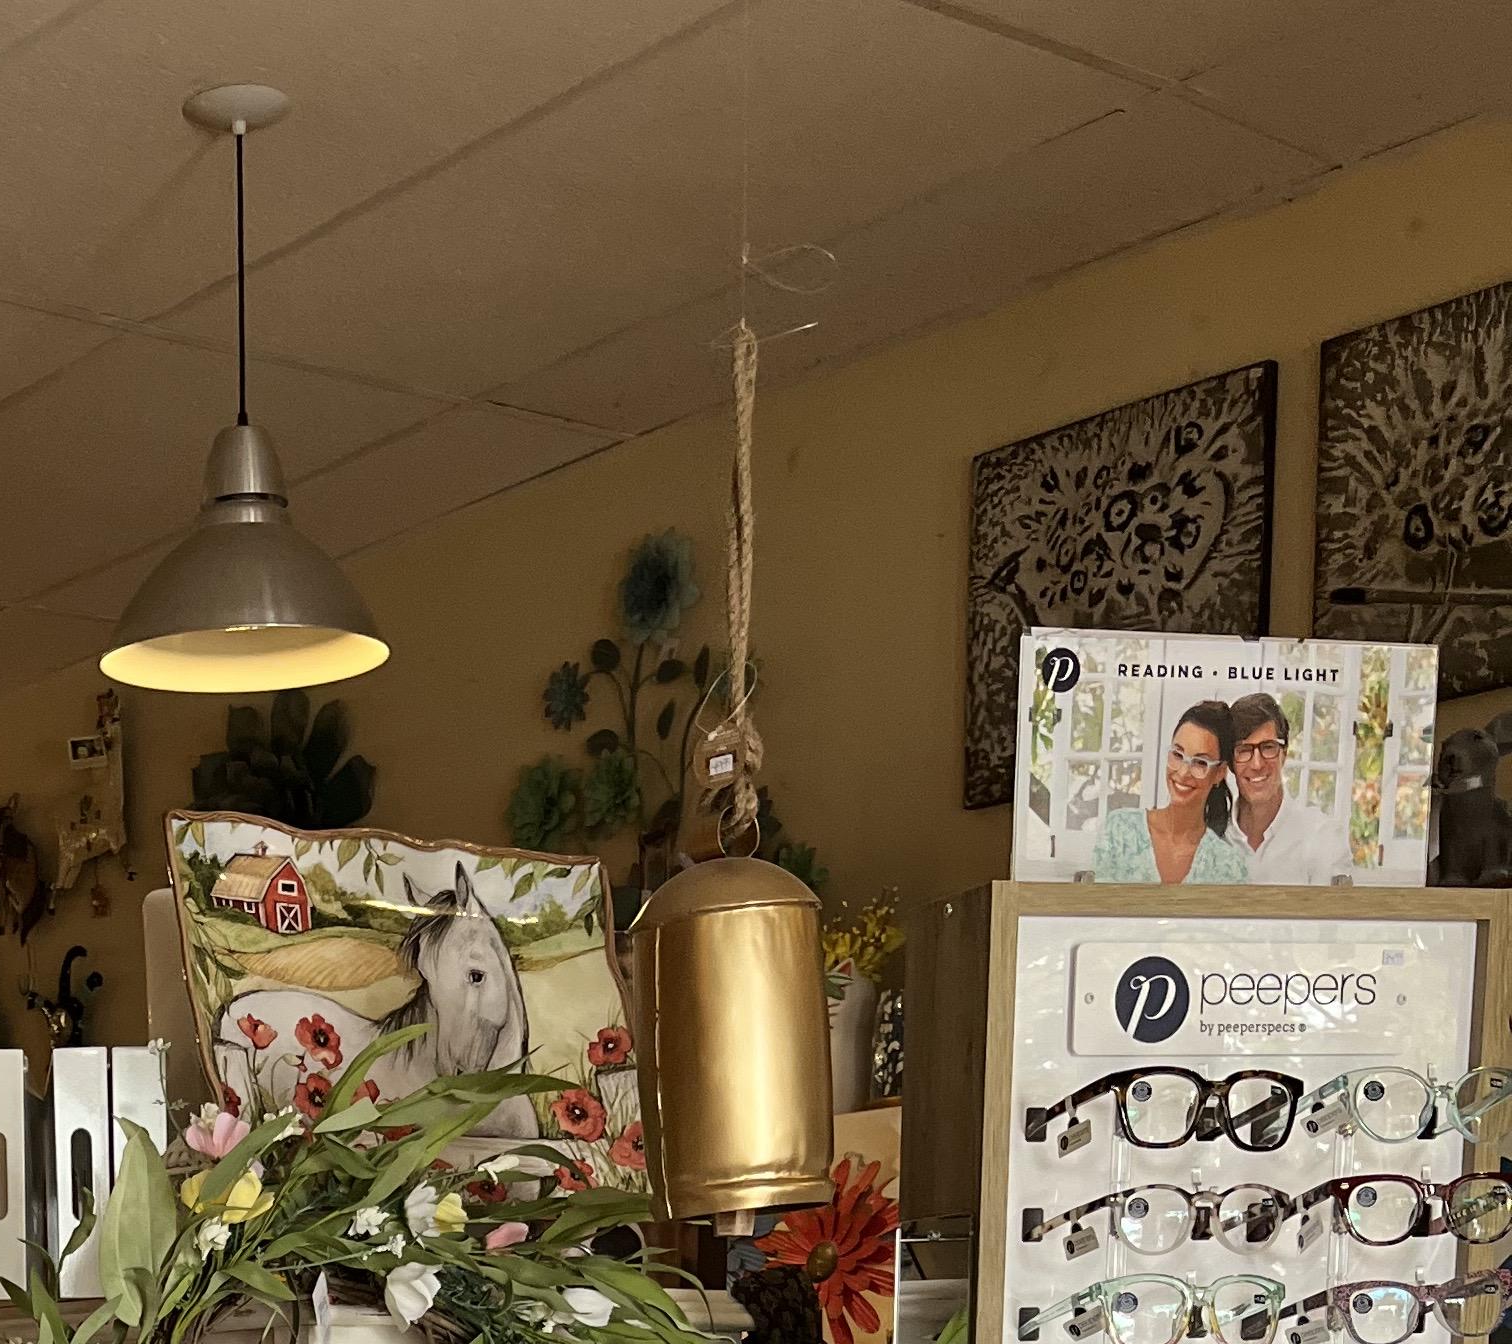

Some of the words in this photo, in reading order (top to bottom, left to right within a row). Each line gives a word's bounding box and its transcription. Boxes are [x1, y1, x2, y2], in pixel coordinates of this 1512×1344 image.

[1118, 662, 1204, 679] READING
[1227, 667, 1276, 682] BLUE
[1284, 668, 1340, 683] LIGHT
[1199, 972, 1377, 1014] peepers
[1199, 1020, 1215, 1036] by
[1217, 1021, 1297, 1036] peeperspecs
